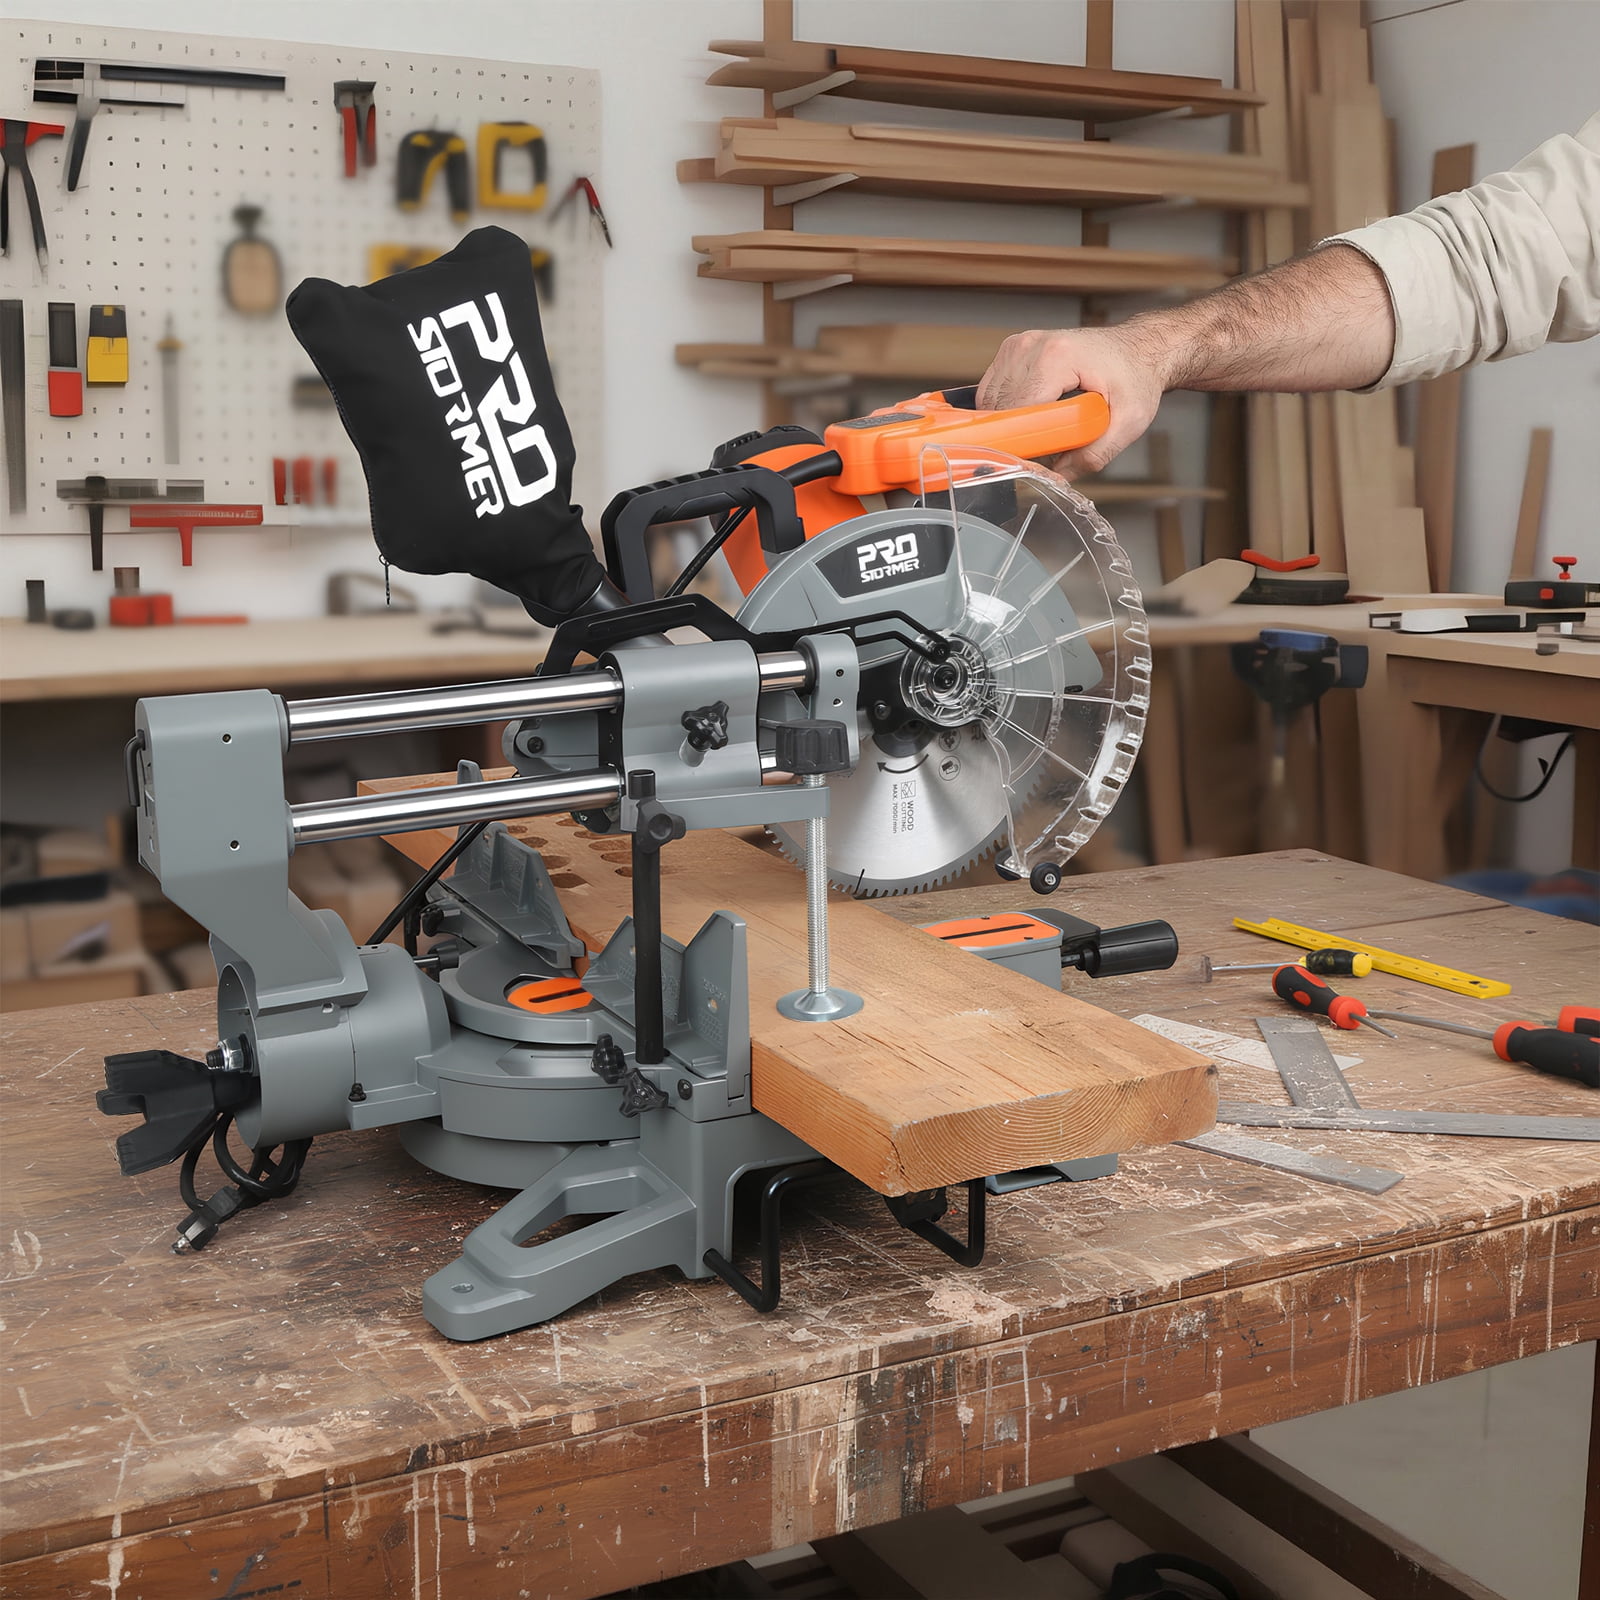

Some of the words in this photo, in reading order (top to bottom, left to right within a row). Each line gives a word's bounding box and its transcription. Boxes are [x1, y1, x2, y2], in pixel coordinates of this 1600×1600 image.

[407, 316, 505, 519] STORMER
[439, 292, 557, 507] PRO
[857, 533, 918, 571] PRO
[860, 558, 920, 583] STORMER
